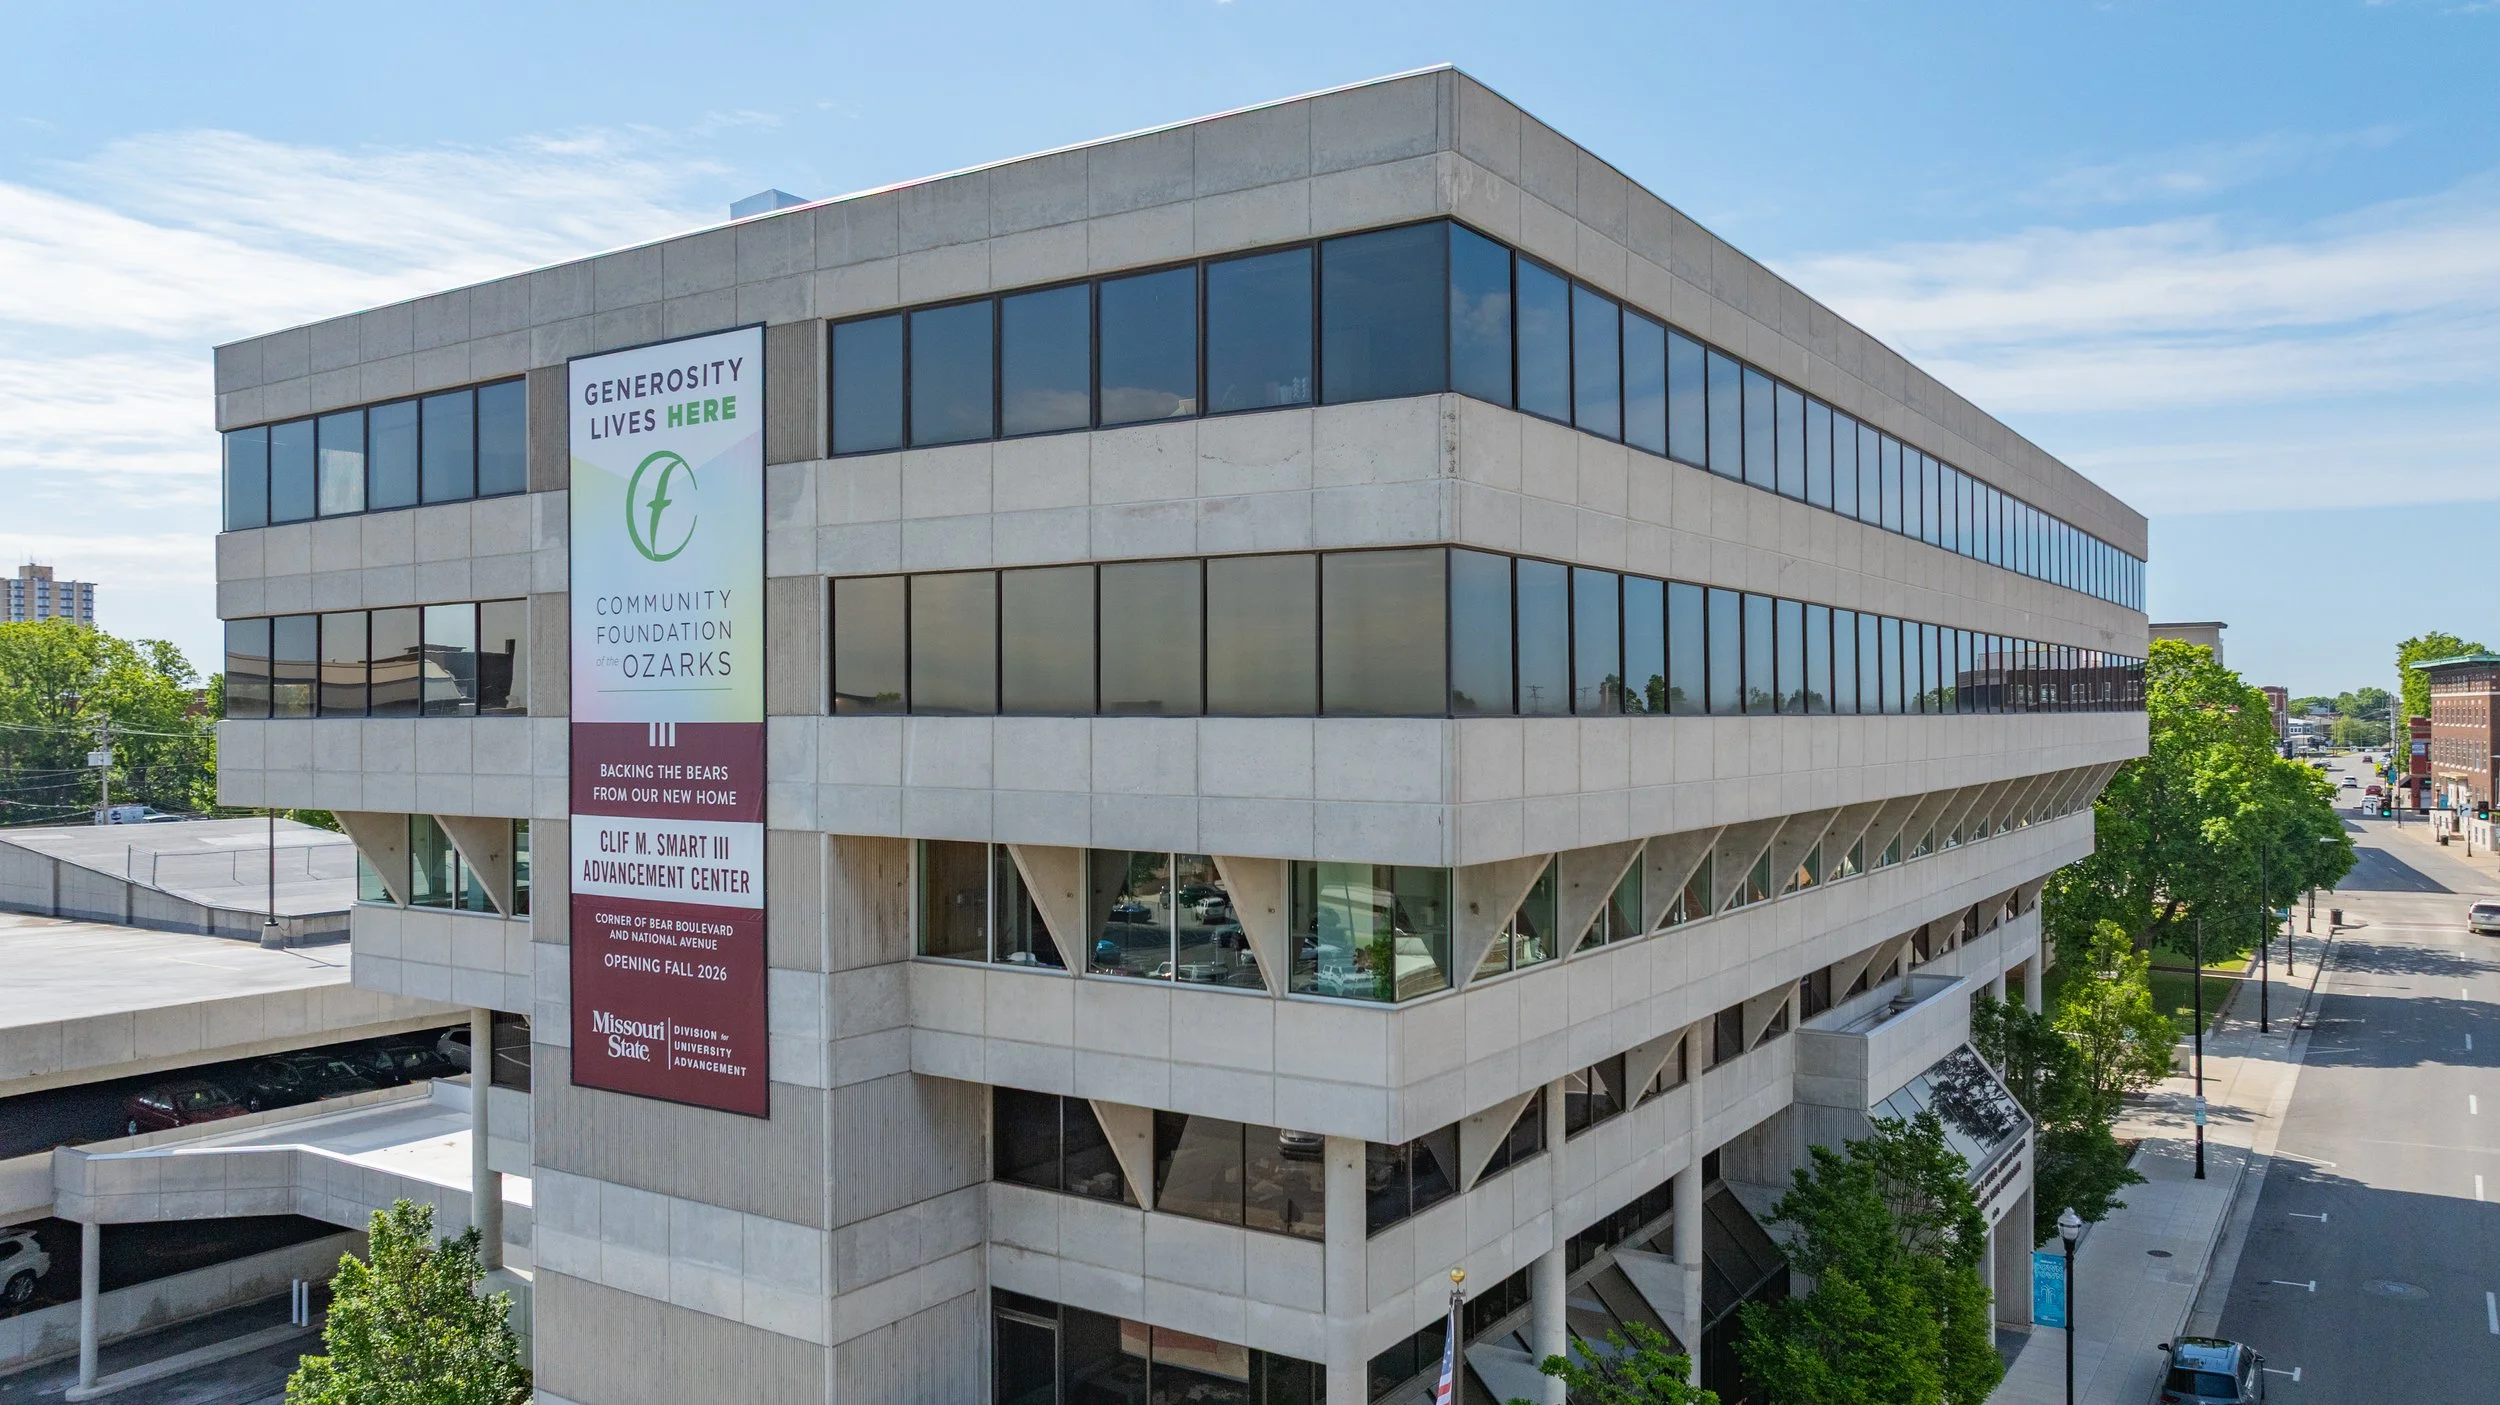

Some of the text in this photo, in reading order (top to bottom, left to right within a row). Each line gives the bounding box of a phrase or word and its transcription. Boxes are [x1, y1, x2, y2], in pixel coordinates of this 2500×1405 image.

[585, 357, 743, 406] GENEROSITY
[591, 396, 736, 439] LIVES HERE
[597, 590, 732, 616] COMMUNITY
[597, 621, 732, 644] FOUNDATION
[596, 651, 731, 678] of the OZARKS
[600, 763, 728, 780] BACKING THE BEARS
[594, 787, 736, 805] FROM OUR NEW HOME
[600, 830, 729, 860] CLIF M. SMART III
[583, 860, 750, 894] ADVANCEMENT CENTER
[595, 913, 733, 936] CORNER OF BEAR BOULEVARD
[610, 929, 717, 950] AND NATIONAL AVENUE
[604, 954, 727, 981] OPENING FALL 2026
[592, 1010, 664, 1041] Missouri
[674, 1026, 729, 1041] DIVISION for
[674, 1041, 732, 1058] UNIVERSITY
[674, 1057, 746, 1076] ADVANCEMENT
